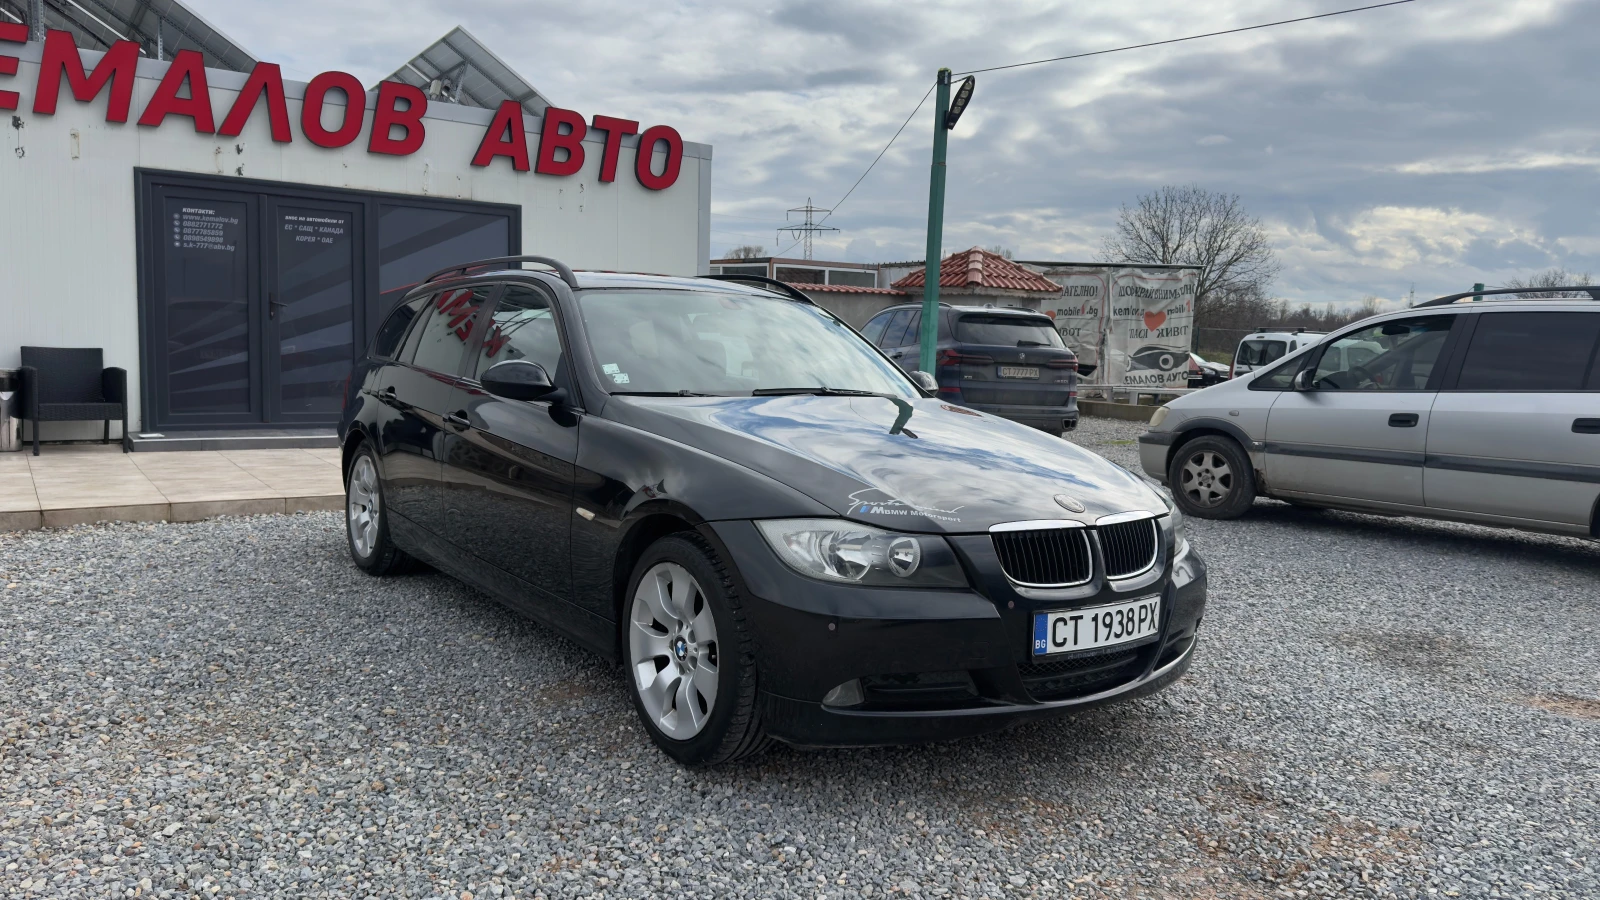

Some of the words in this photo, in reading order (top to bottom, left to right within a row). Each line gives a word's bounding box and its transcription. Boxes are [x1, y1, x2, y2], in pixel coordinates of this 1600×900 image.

[471, 101, 684, 190] АВТО
[182, 215, 239, 225] www.kemalov.bg
[298, 225, 314, 233] САЩ
[319, 226, 344, 235] КАНАДА
[1123, 374, 1165, 385] ЕМАЛОВ
[910, 510, 962, 523] Motorsport
[1052, 615, 1084, 648] CT
[1091, 607, 1135, 643] 1938
[1035, 639, 1047, 650] BG
